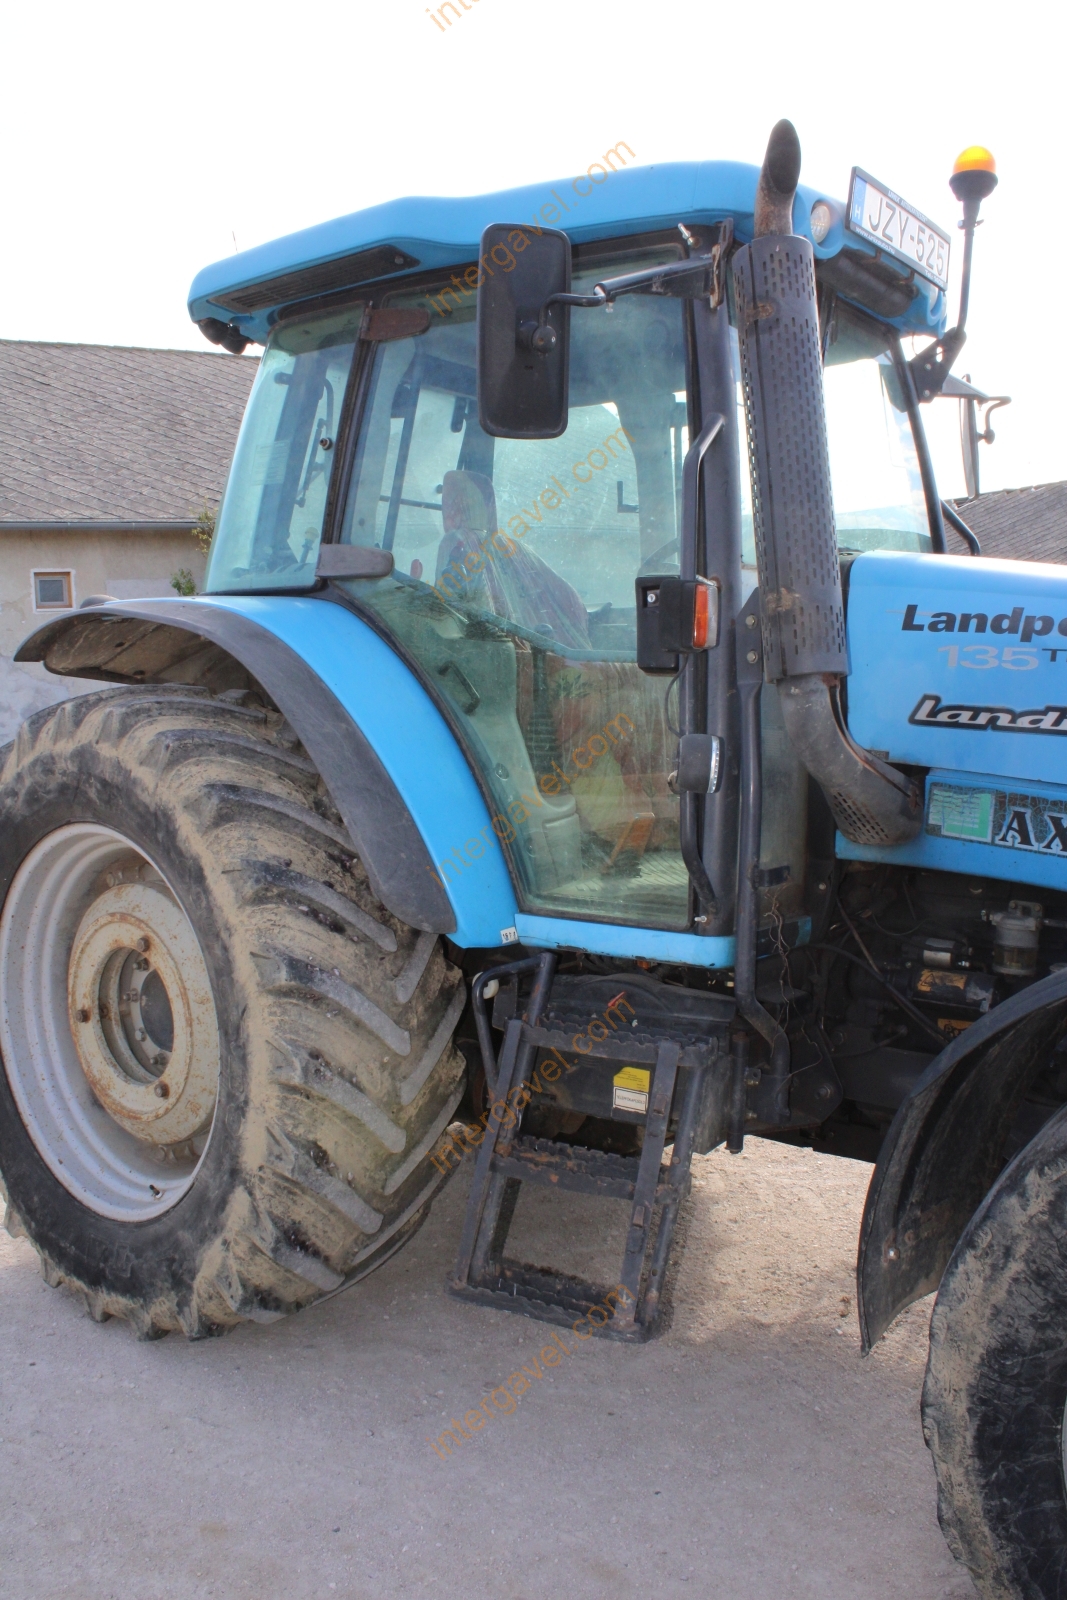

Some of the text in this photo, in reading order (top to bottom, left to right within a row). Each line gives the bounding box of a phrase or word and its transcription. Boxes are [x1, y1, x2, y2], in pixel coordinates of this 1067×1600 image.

[854, 204, 861, 220] H
[868, 196, 945, 277] JZY-525
[938, 645, 1067, 671] 135 T
